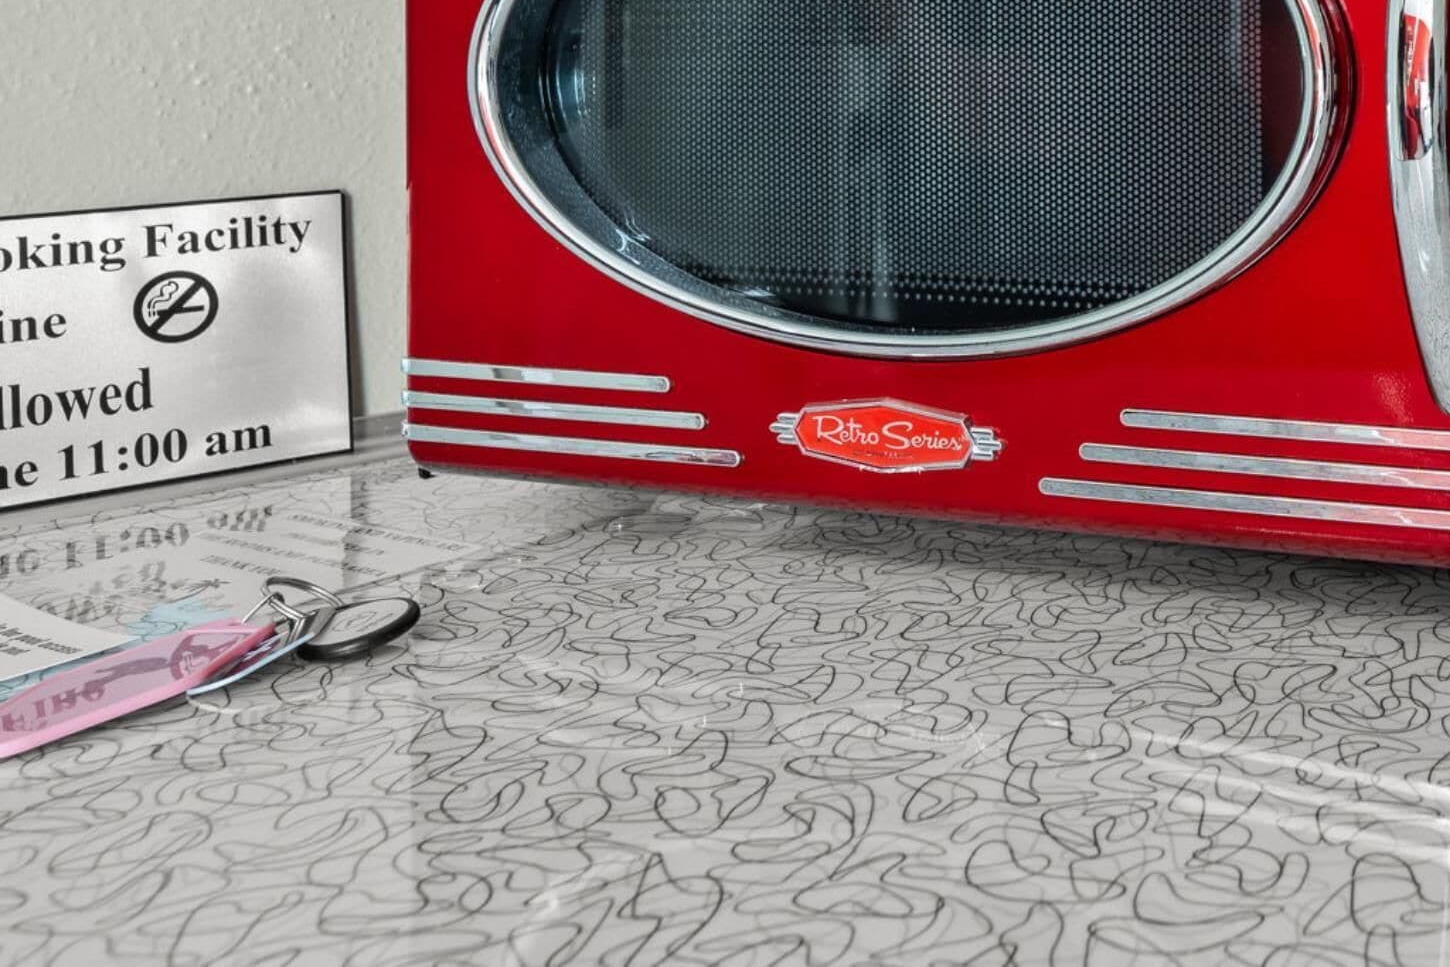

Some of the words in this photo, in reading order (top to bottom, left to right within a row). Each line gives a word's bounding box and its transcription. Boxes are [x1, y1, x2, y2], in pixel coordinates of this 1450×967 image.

[142, 214, 312, 259] Facility
[58, 428, 188, 481] 11:00
[205, 423, 273, 456] am
[812, 415, 879, 445] Retro
[882, 421, 962, 450] Series
